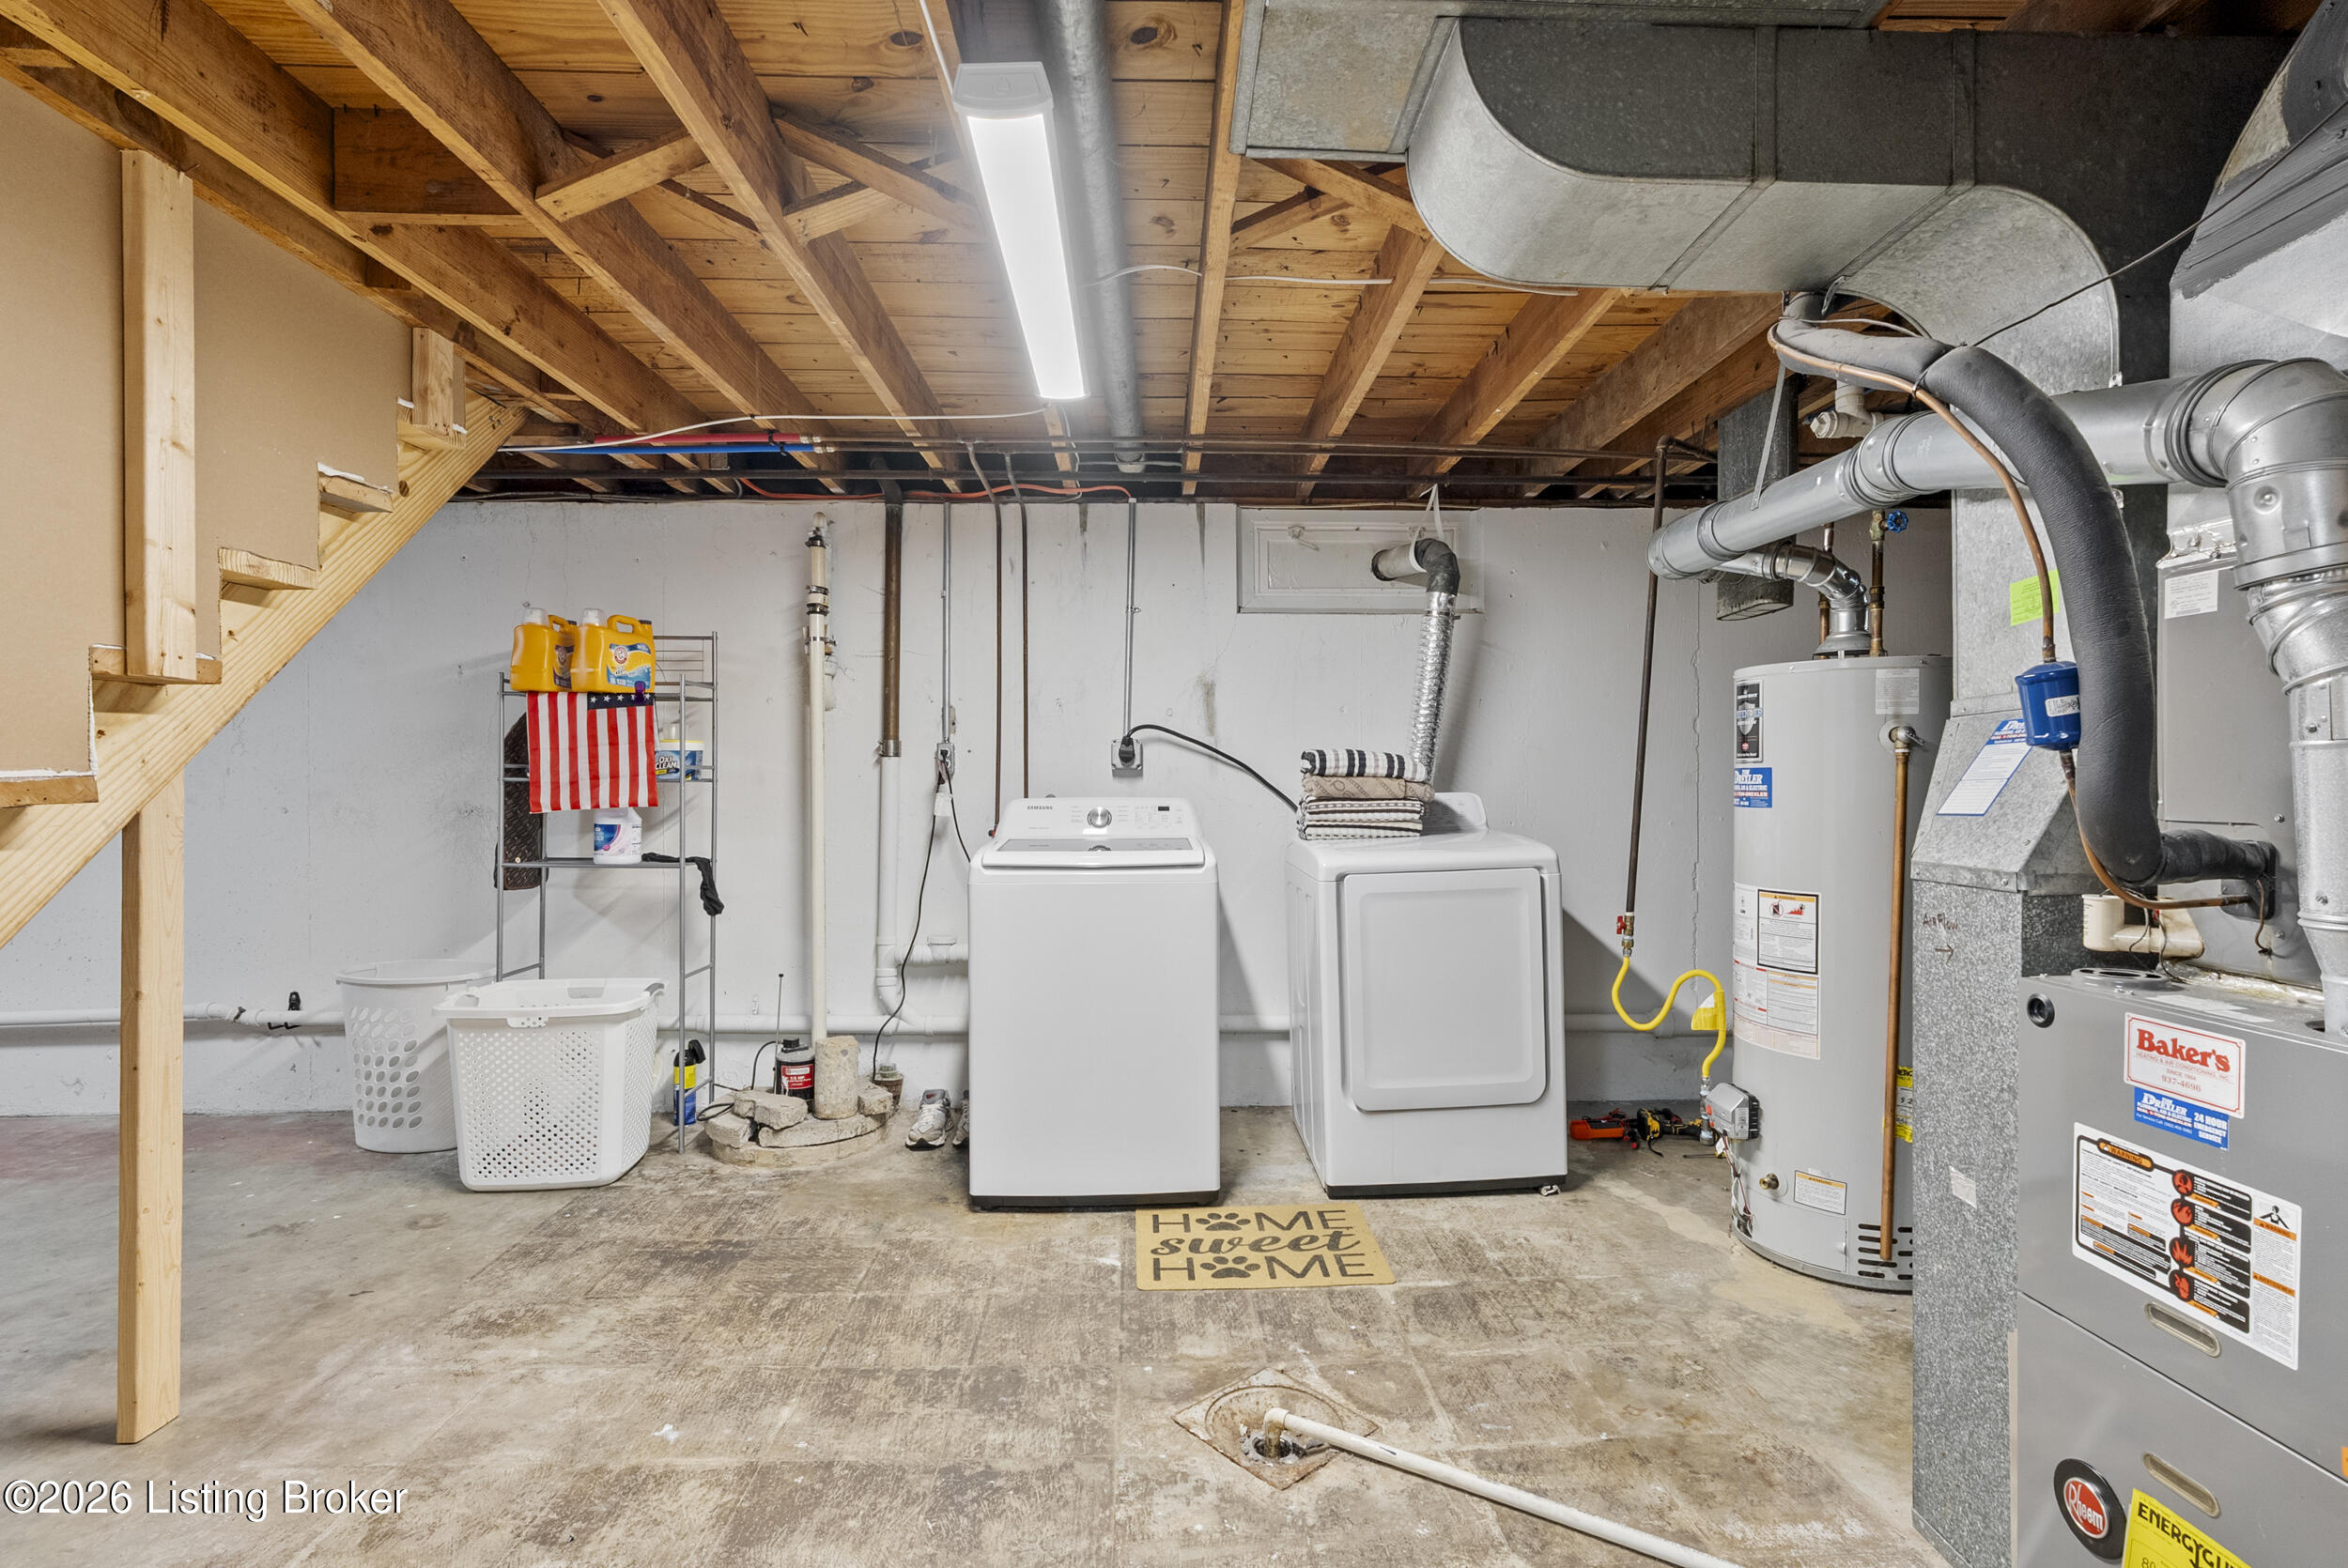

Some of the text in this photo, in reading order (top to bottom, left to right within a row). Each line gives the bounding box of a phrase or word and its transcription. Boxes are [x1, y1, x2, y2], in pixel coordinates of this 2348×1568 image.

[656, 761, 677, 770] CLEAN
[659, 755, 672, 763] OXI
[2137, 1028, 2231, 1072] Baker's
[2194, 1112, 2204, 1123] 24
[2205, 1115, 2228, 1130] HOUR
[2110, 1146, 2142, 1164] WARNING
[1151, 1230, 1361, 1255] sweet
[2068, 1483, 2104, 1532] Rheem
